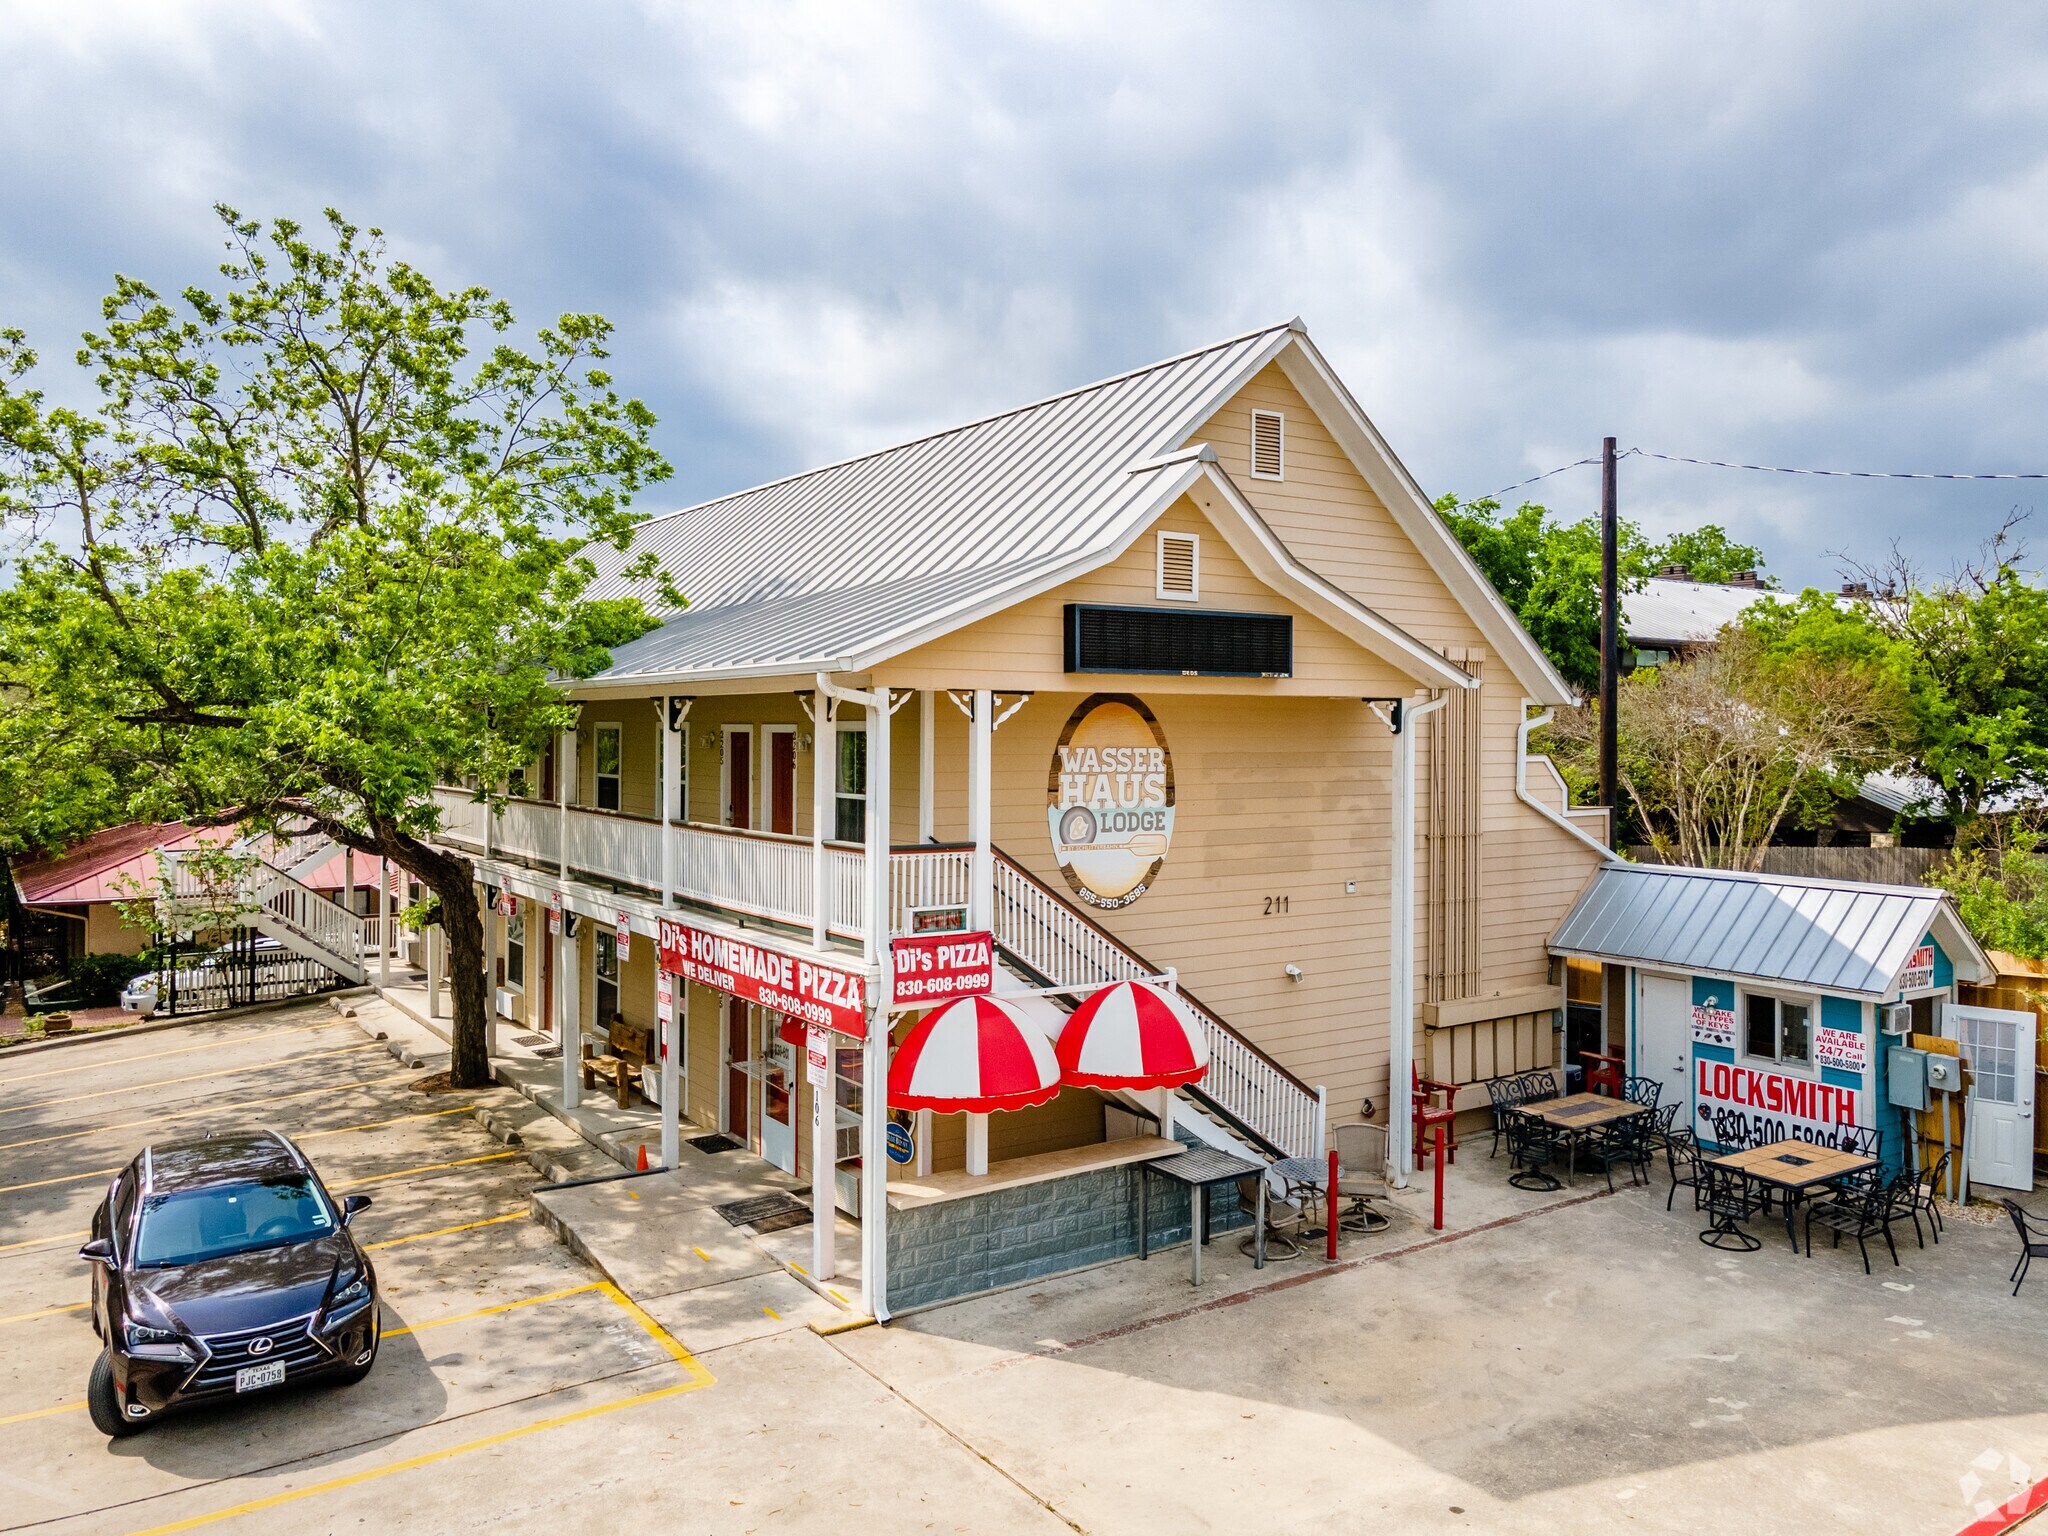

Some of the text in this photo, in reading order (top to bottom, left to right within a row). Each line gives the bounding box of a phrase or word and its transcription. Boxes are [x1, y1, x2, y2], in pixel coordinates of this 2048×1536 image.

[1059, 747, 1166, 773] WASSER
[1060, 773, 1166, 810] HAUS
[1100, 811, 1166, 833] LODGE
[1079, 883, 1146, 908] 855-550-3685
[1263, 895, 1289, 915] 211
[912, 911, 962, 931] OPEN
[661, 923, 687, 955] Di's
[691, 931, 794, 991] HOMEMADE
[799, 962, 863, 1013] PIZZA
[896, 942, 990, 974] Di's PIZZA
[682, 959, 735, 993] WE DELIVER
[896, 972, 990, 997] 830-608-0999
[758, 987, 832, 1026] 830-608-0999
[1692, 1012, 1734, 1024] ALL TYPES
[1708, 1021, 1730, 1030] KEYS
[1822, 1028, 1858, 1041] WE ARE
[1815, 1035, 1866, 1051] AVAILABLE
[1819, 1044, 1863, 1061] 24/7 Call
[1820, 1055, 1861, 1071] 830-500-5800
[1699, 1060, 1855, 1128] LOCKSMITH
